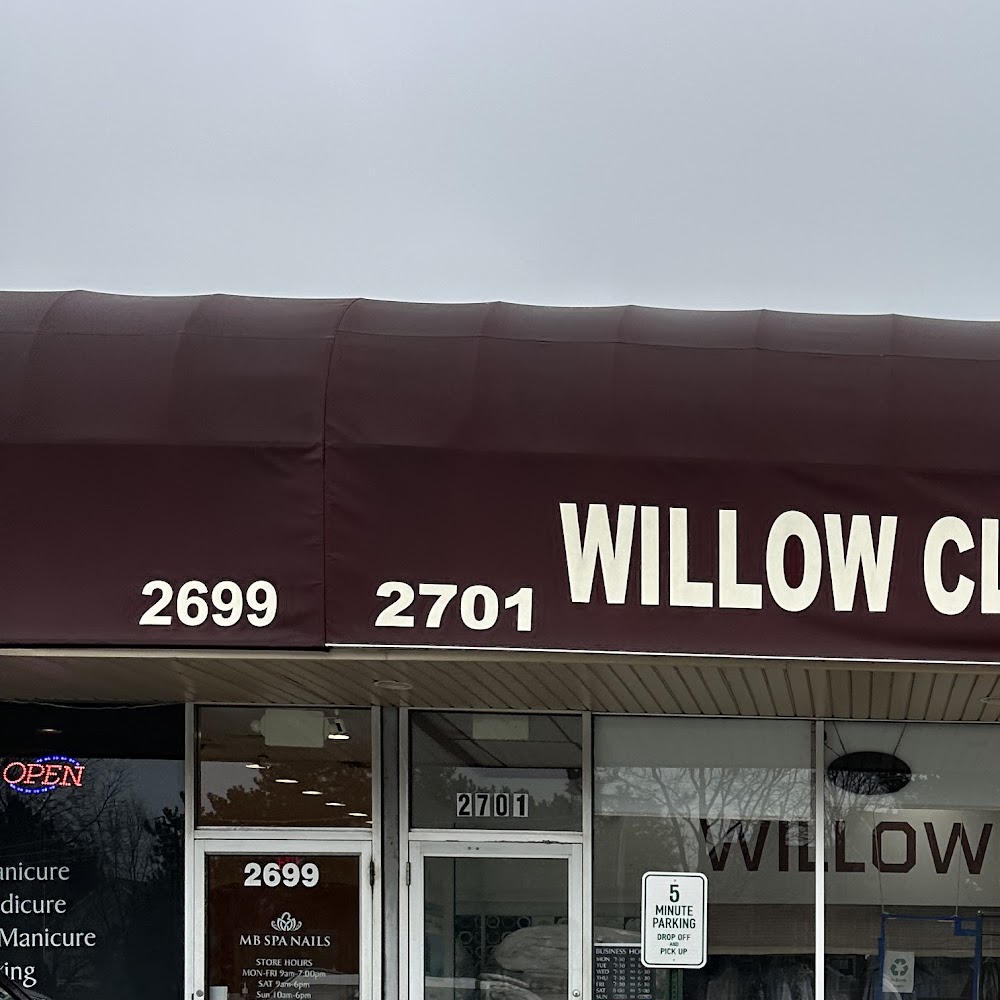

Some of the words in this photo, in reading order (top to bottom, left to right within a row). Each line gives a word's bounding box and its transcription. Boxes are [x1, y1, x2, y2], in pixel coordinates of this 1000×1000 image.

[559, 503, 898, 612] WILLOW
[138, 580, 278, 627] 2699
[374, 581, 533, 632] 2701
[3, 761, 86, 787] OPEN
[458, 793, 525, 817] 2701
[700, 819, 993, 875] WILLOW
[243, 861, 320, 888] 2699
[669, 884, 680, 903] 5
[655, 904, 694, 916] MINUTE
[652, 917, 696, 929] PARKING
[0, 927, 97, 947] Manicure
[239, 935, 261, 946] MB
[264, 935, 288, 946] SPA
[290, 936, 331, 947] NAILS
[657, 933, 676, 941] DROP
[677, 933, 692, 941] OFF
[660, 947, 676, 955] PICK
[256, 958, 282, 967] STORE
[284, 959, 314, 967] HOURS
[242, 969, 278, 977] MON-FRI
[258, 980, 274, 988] SAT
[275, 980, 310, 990] 9am-6pm
[273, 991, 312, 1000] 10am-6pm
